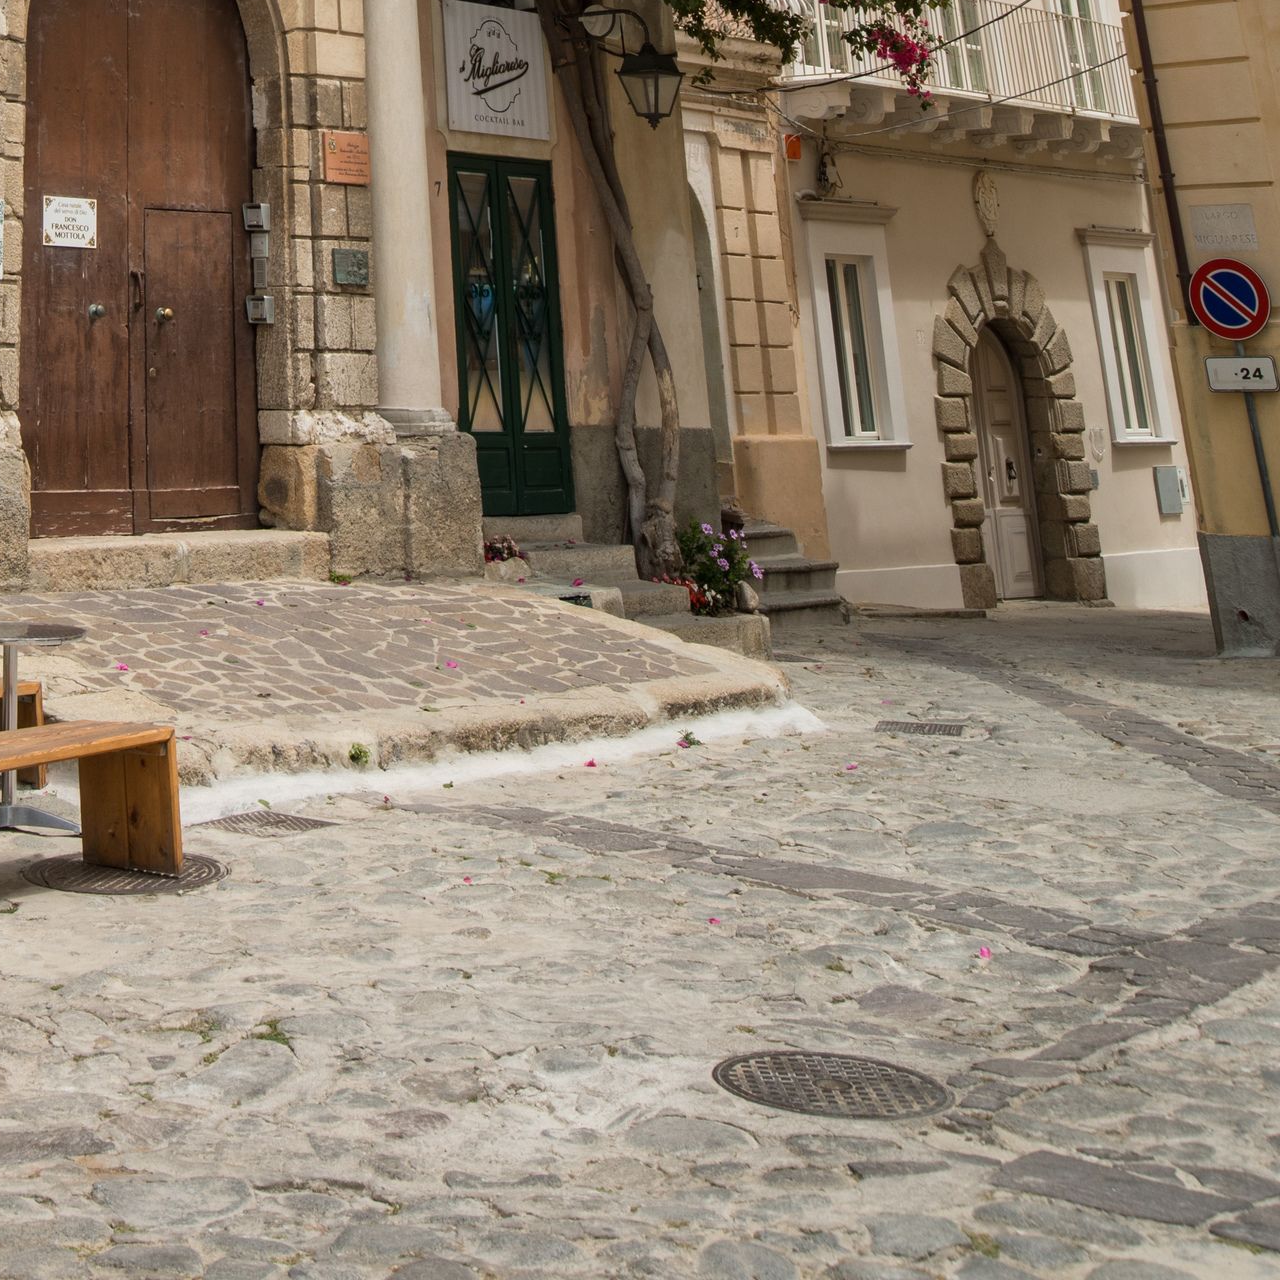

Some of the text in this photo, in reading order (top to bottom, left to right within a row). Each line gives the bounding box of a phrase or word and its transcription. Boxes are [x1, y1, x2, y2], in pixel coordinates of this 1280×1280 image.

[474, 113, 526, 127] COCKTAIL BAR
[434, 180, 441, 198] 7
[51, 223, 90, 232] FRANCESCO
[54, 231, 86, 240] MOTTOLA
